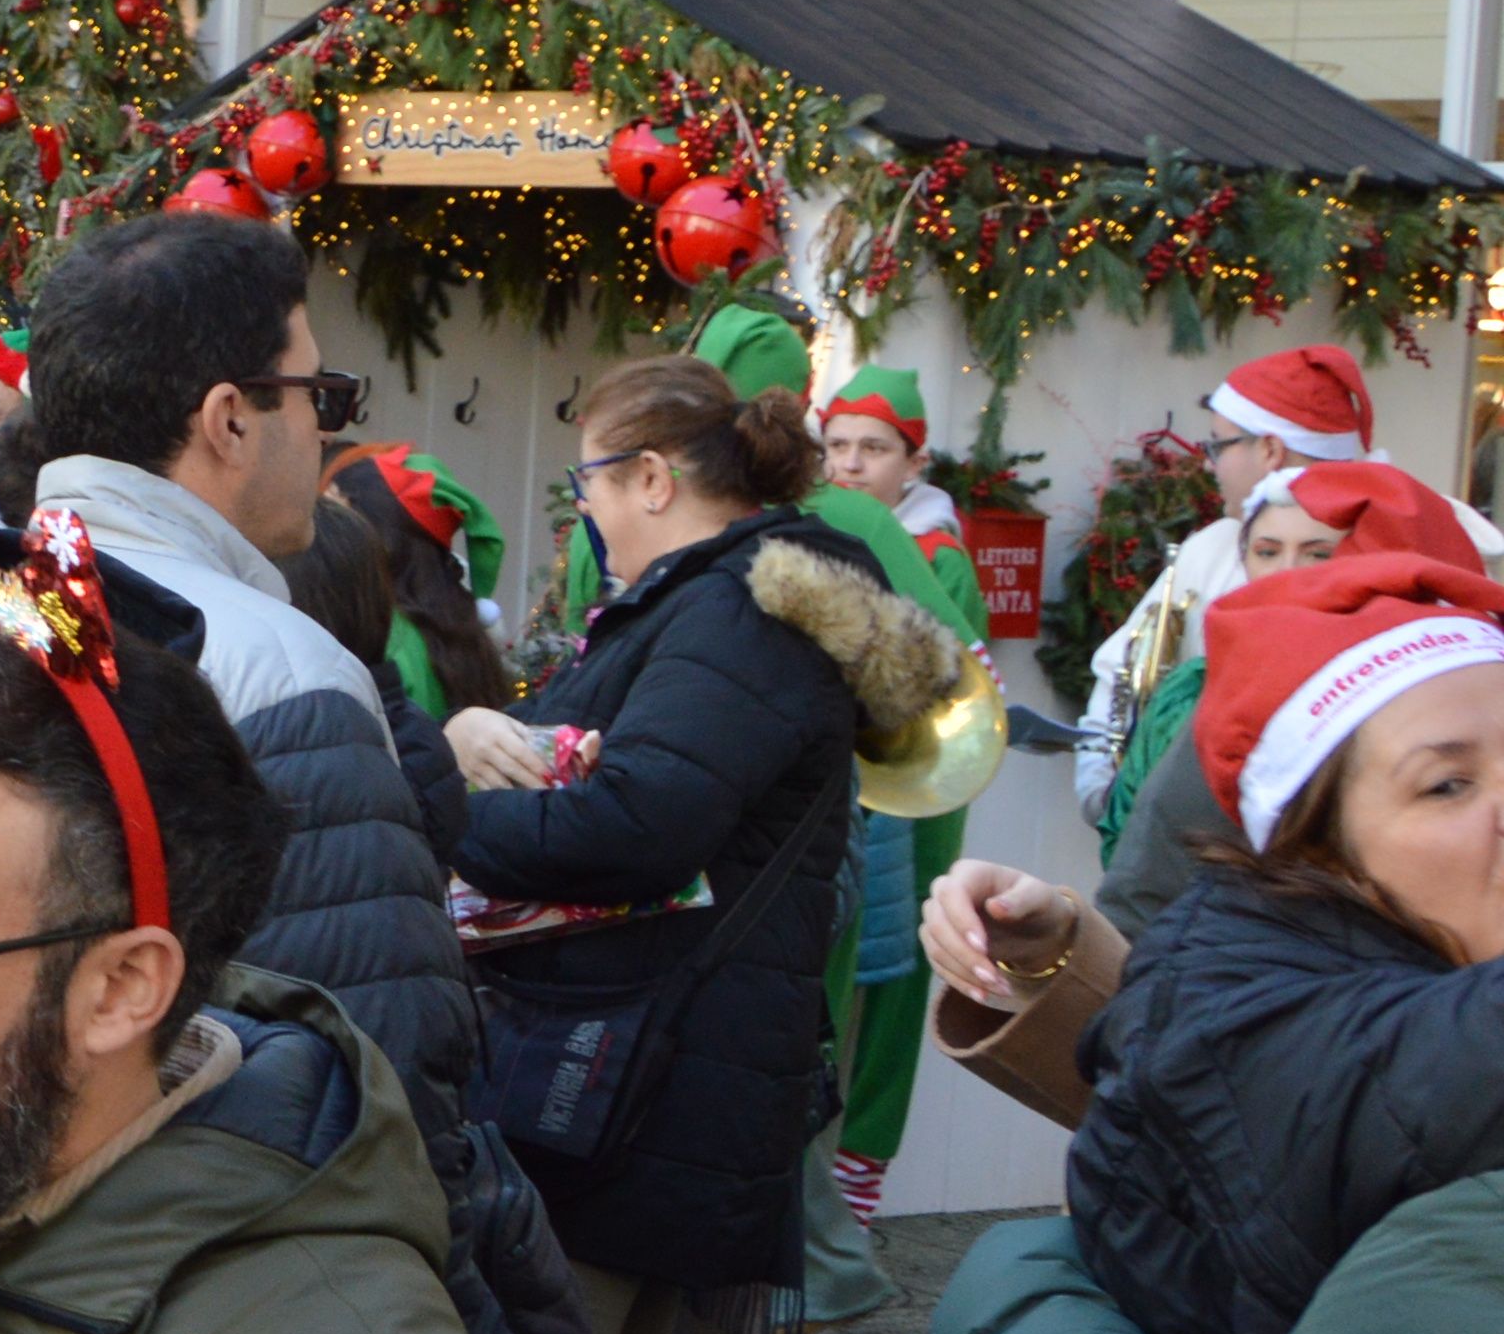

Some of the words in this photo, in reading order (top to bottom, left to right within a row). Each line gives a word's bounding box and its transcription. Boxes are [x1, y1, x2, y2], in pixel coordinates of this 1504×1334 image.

[362, 117, 521, 156] Christmas
[977, 547, 1037, 566] LETTERS
[993, 566, 1017, 587] TO
[986, 589, 1033, 614] ANTA
[537, 1060, 590, 1134] VICTORIA
